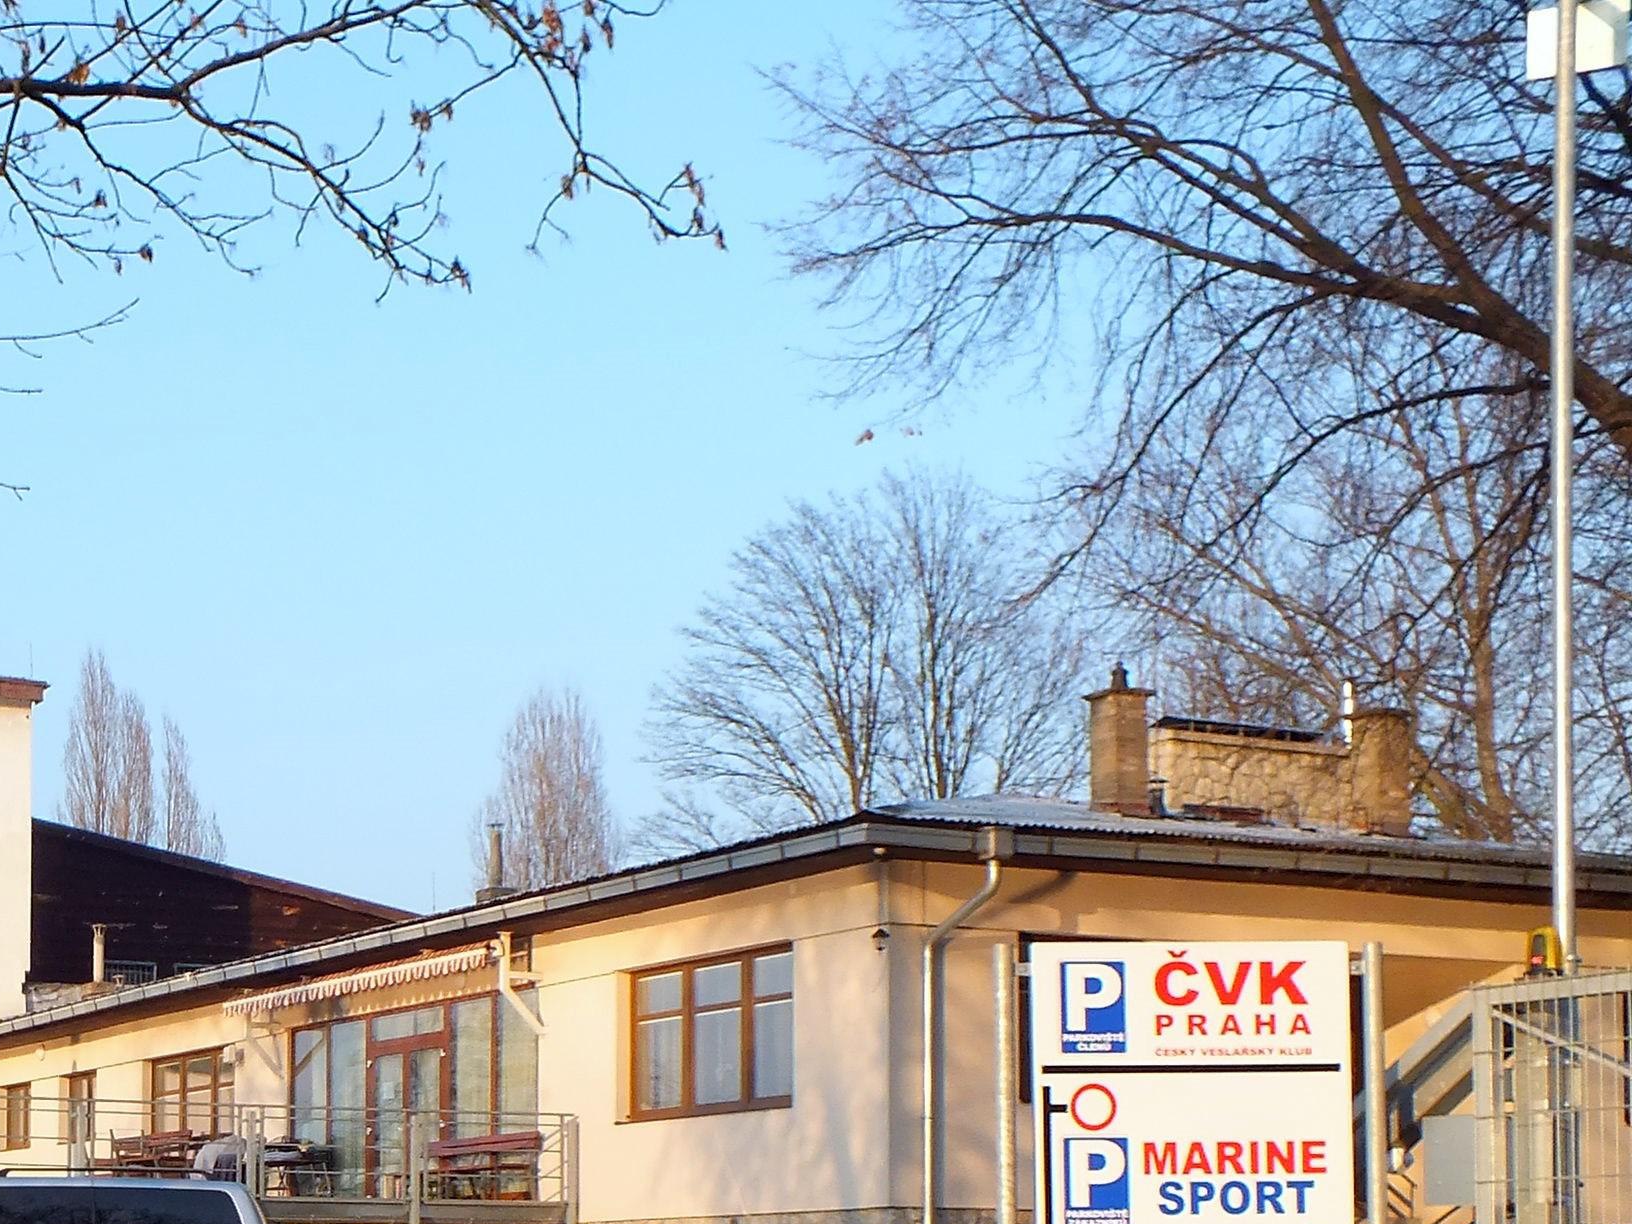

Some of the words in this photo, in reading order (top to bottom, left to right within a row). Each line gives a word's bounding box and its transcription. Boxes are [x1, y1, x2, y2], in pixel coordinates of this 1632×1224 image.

[1154, 950, 1309, 1006] ČVK
[1066, 963, 1123, 1031] P
[1154, 1014, 1312, 1036] PRAHA
[1279, 1047, 1313, 1056] KLUB
[1067, 1140, 1127, 1208] P
[1143, 1140, 1328, 1175] MARINE
[1158, 1180, 1315, 1215] SPORT
